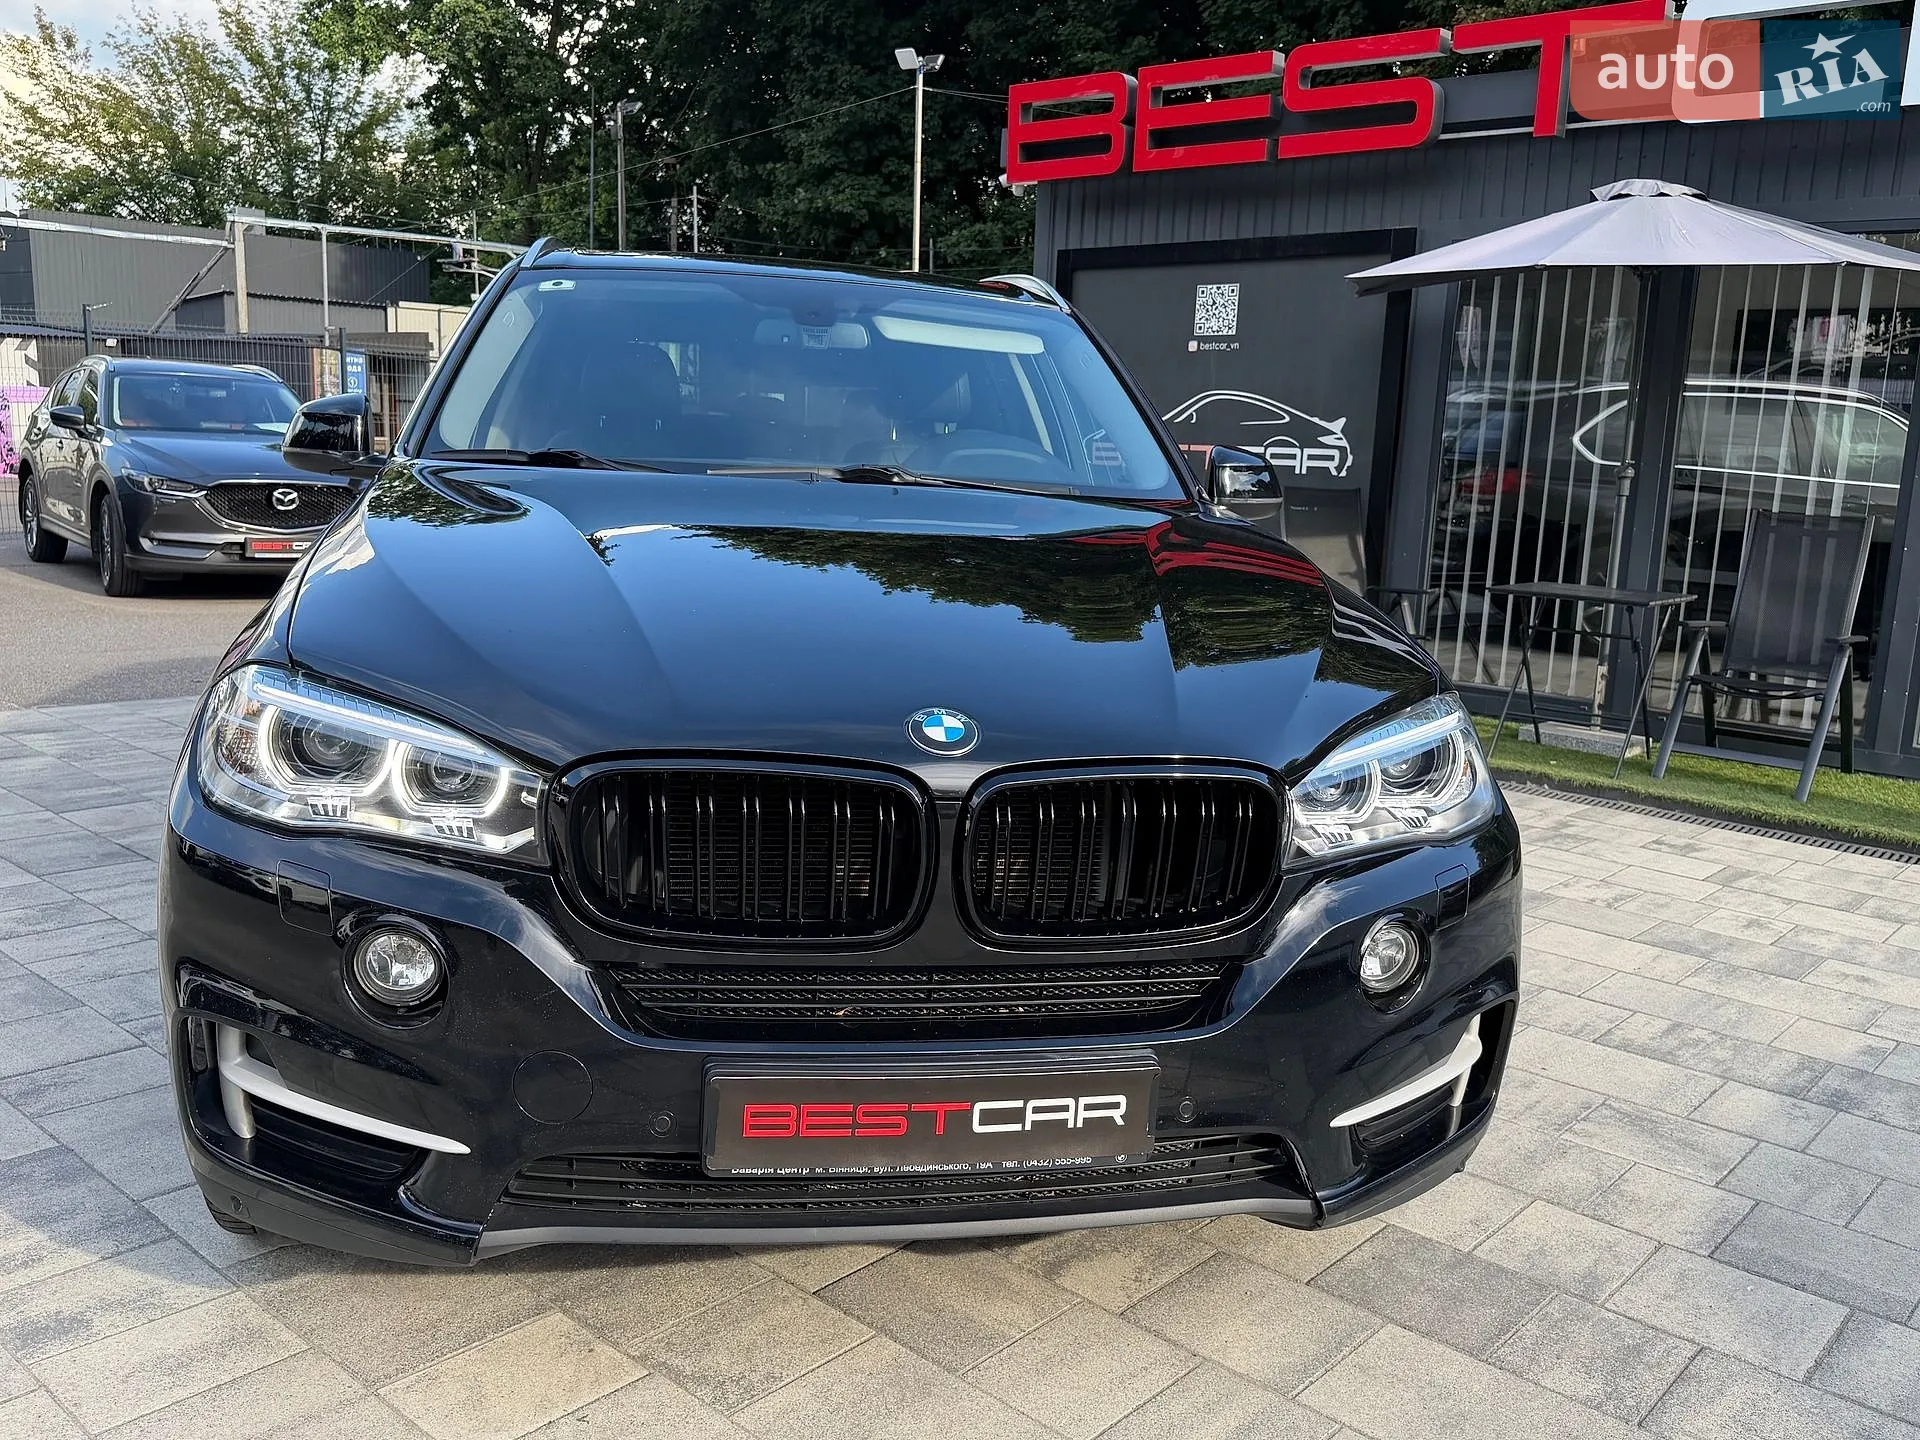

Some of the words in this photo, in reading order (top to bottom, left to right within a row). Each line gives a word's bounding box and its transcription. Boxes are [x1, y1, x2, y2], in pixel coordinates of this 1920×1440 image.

[1199, 341, 1240, 351] bestcar_vn
[914, 708, 969, 722] BMW
[742, 1093, 1128, 1138] BESTCAR
